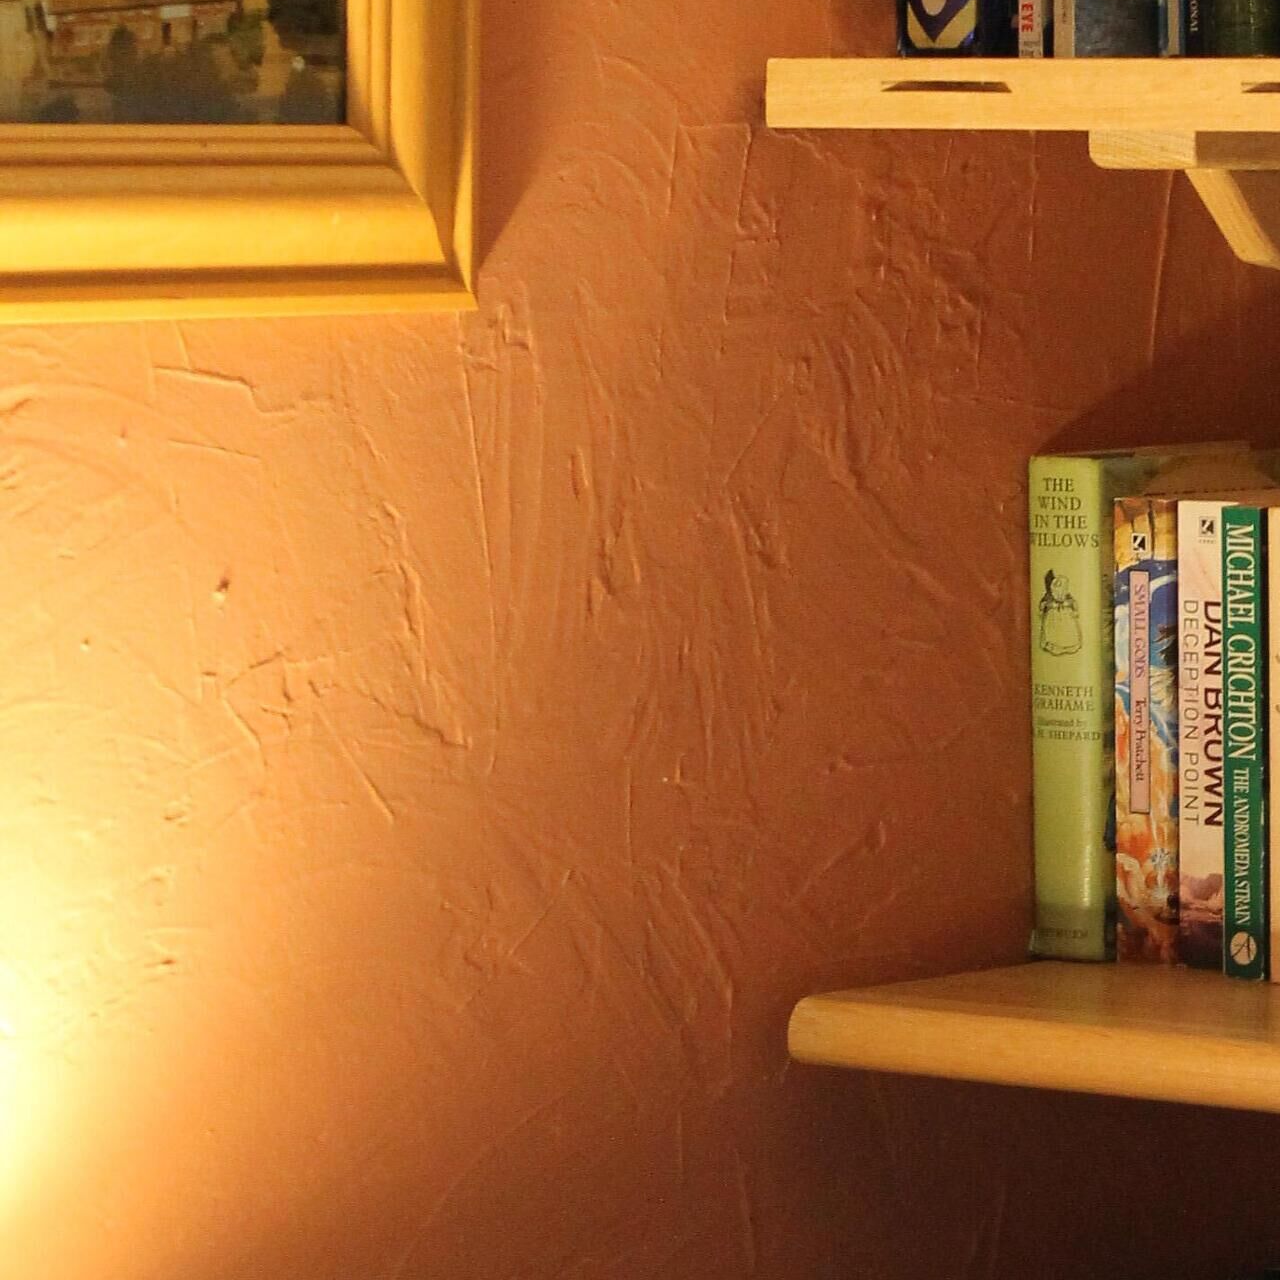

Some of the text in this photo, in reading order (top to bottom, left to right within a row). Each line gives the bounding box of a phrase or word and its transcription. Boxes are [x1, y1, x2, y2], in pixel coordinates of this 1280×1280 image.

[1021, 4, 1034, 32] EYE
[1037, 496, 1081, 511] WIND
[1043, 477, 1074, 492] THE
[1054, 514, 1087, 530] THE
[1133, 583, 1146, 679] SMALL GODS
[1226, 523, 1256, 761] MICHAEL CRICHTON
[1183, 599, 1199, 826] DECEPTION POINT
[1233, 767, 1250, 925] THE ANDROMEDA STRAIN
